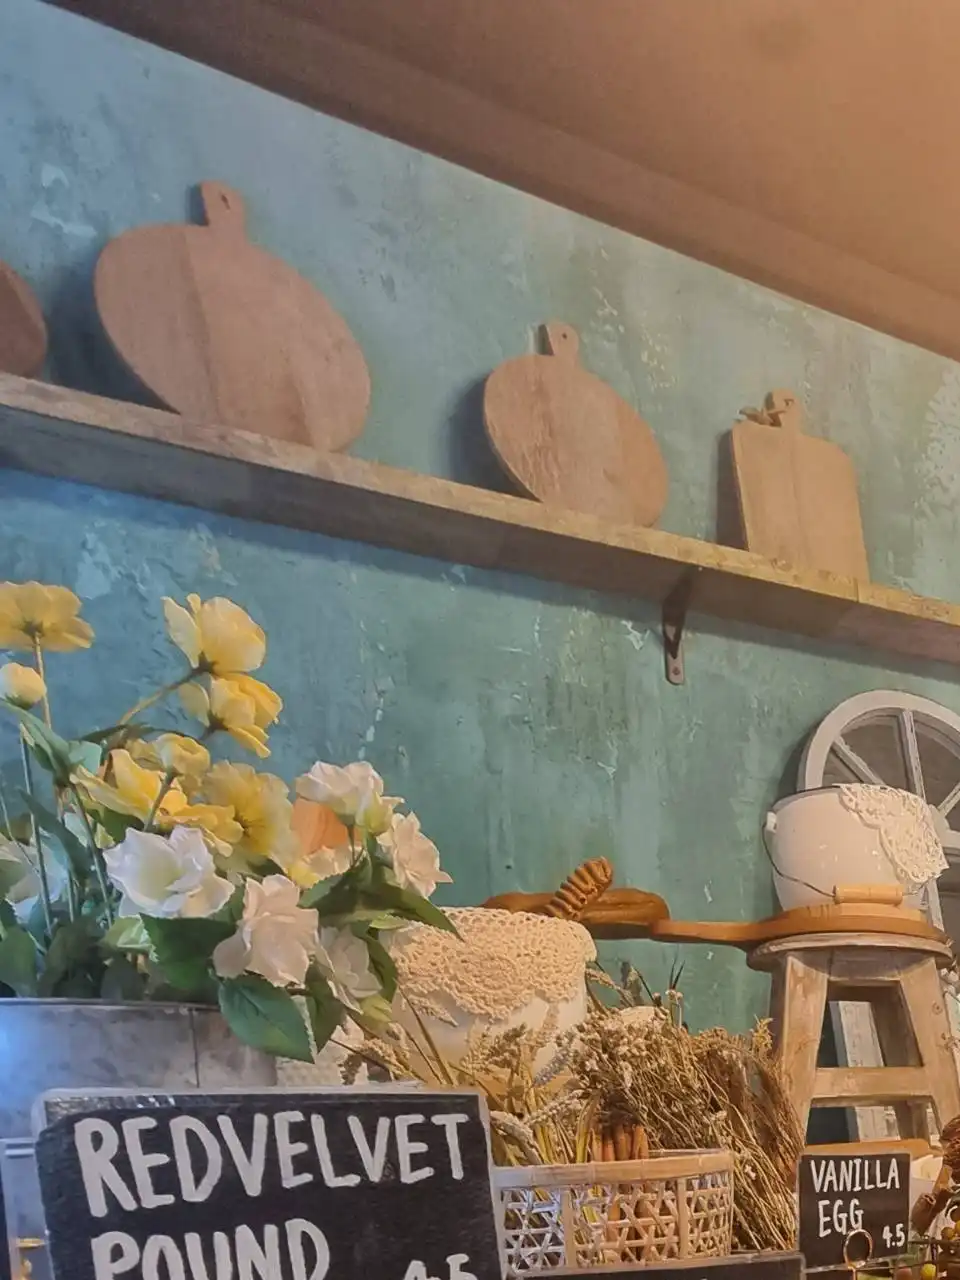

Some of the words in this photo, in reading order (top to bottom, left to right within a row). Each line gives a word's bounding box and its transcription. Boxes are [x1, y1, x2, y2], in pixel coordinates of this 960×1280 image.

[74, 1111, 469, 1218] REDVELVET
[811, 1158, 900, 1192] VANILLA
[818, 1198, 864, 1238] EGG
[883, 1223, 906, 1249] 4.5
